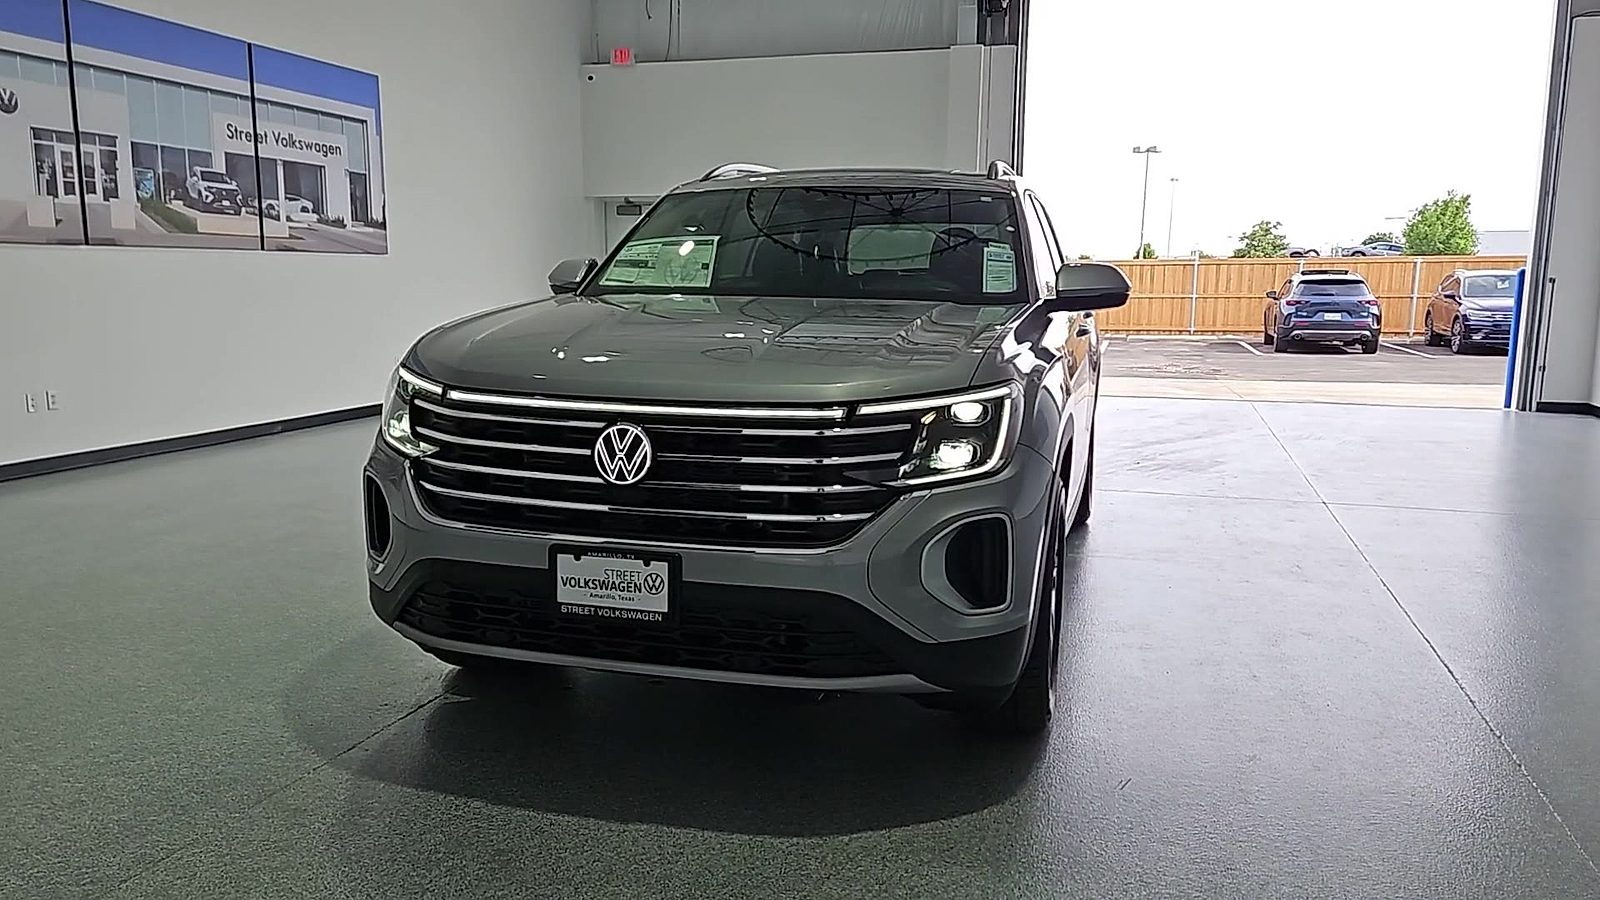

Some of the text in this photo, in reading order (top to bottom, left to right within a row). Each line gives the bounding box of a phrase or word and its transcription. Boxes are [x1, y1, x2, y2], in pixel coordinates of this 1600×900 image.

[226, 122, 342, 158] Street Volkswagen
[604, 569, 642, 582] STREET
[560, 576, 642, 593] VOLKSWAGEN
[618, 594, 635, 602] Texas
[561, 604, 662, 621] STREET VOLKSWAGEN
